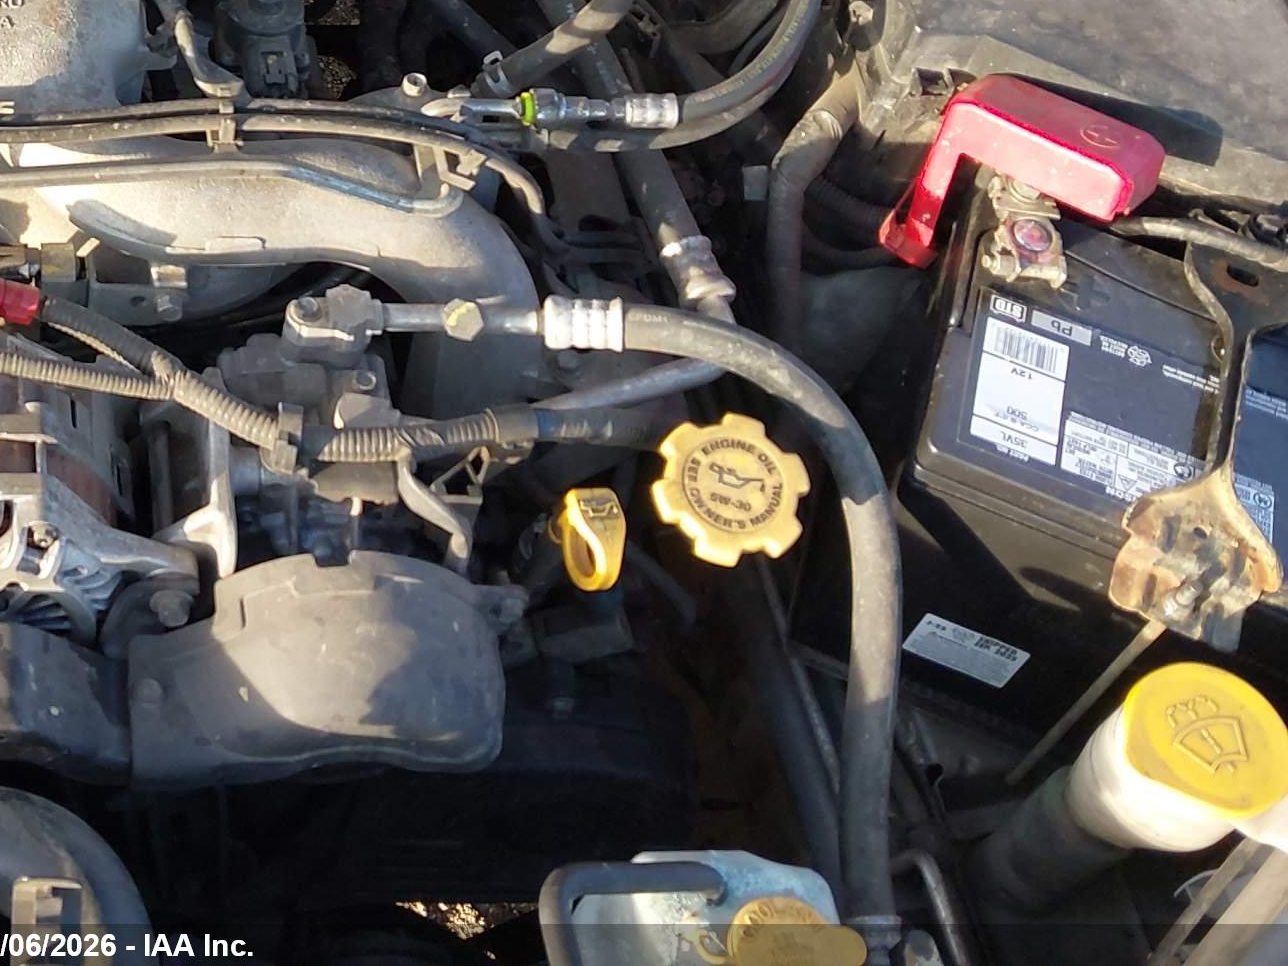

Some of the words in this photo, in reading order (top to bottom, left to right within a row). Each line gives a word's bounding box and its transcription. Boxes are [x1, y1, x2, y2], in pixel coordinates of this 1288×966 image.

[1050, 320, 1073, 336] Pb
[1011, 367, 1033, 380] 12V
[1006, 406, 1028, 420] 500
[999, 431, 1028, 449] 35VL
[702, 438, 755, 456] ENGINE
[757, 452, 777, 475] OIL
[687, 457, 701, 483] SEE
[690, 487, 746, 530] OWNER'S
[710, 492, 752, 513] 5W-30
[750, 482, 783, 526] MANUAL
